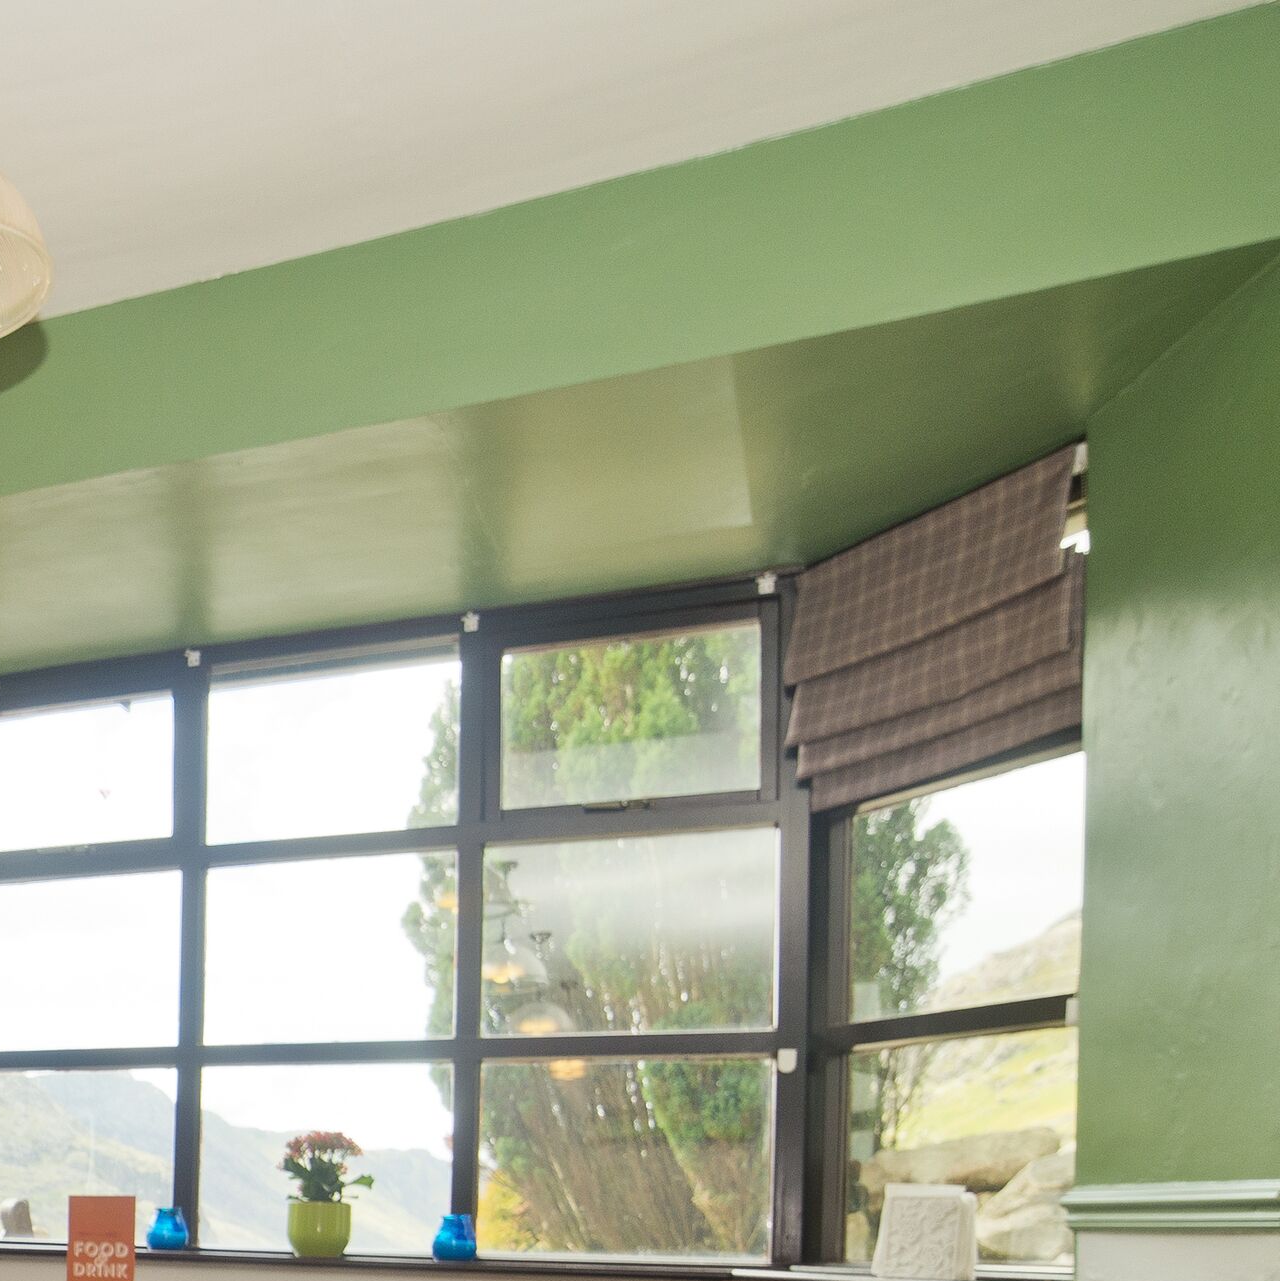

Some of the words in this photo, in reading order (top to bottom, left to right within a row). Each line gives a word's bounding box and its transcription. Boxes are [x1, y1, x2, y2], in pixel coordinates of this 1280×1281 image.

[73, 1240, 129, 1259] FOOD
[94, 1252, 110, 1268] &
[72, 1261, 129, 1279] DRINK
